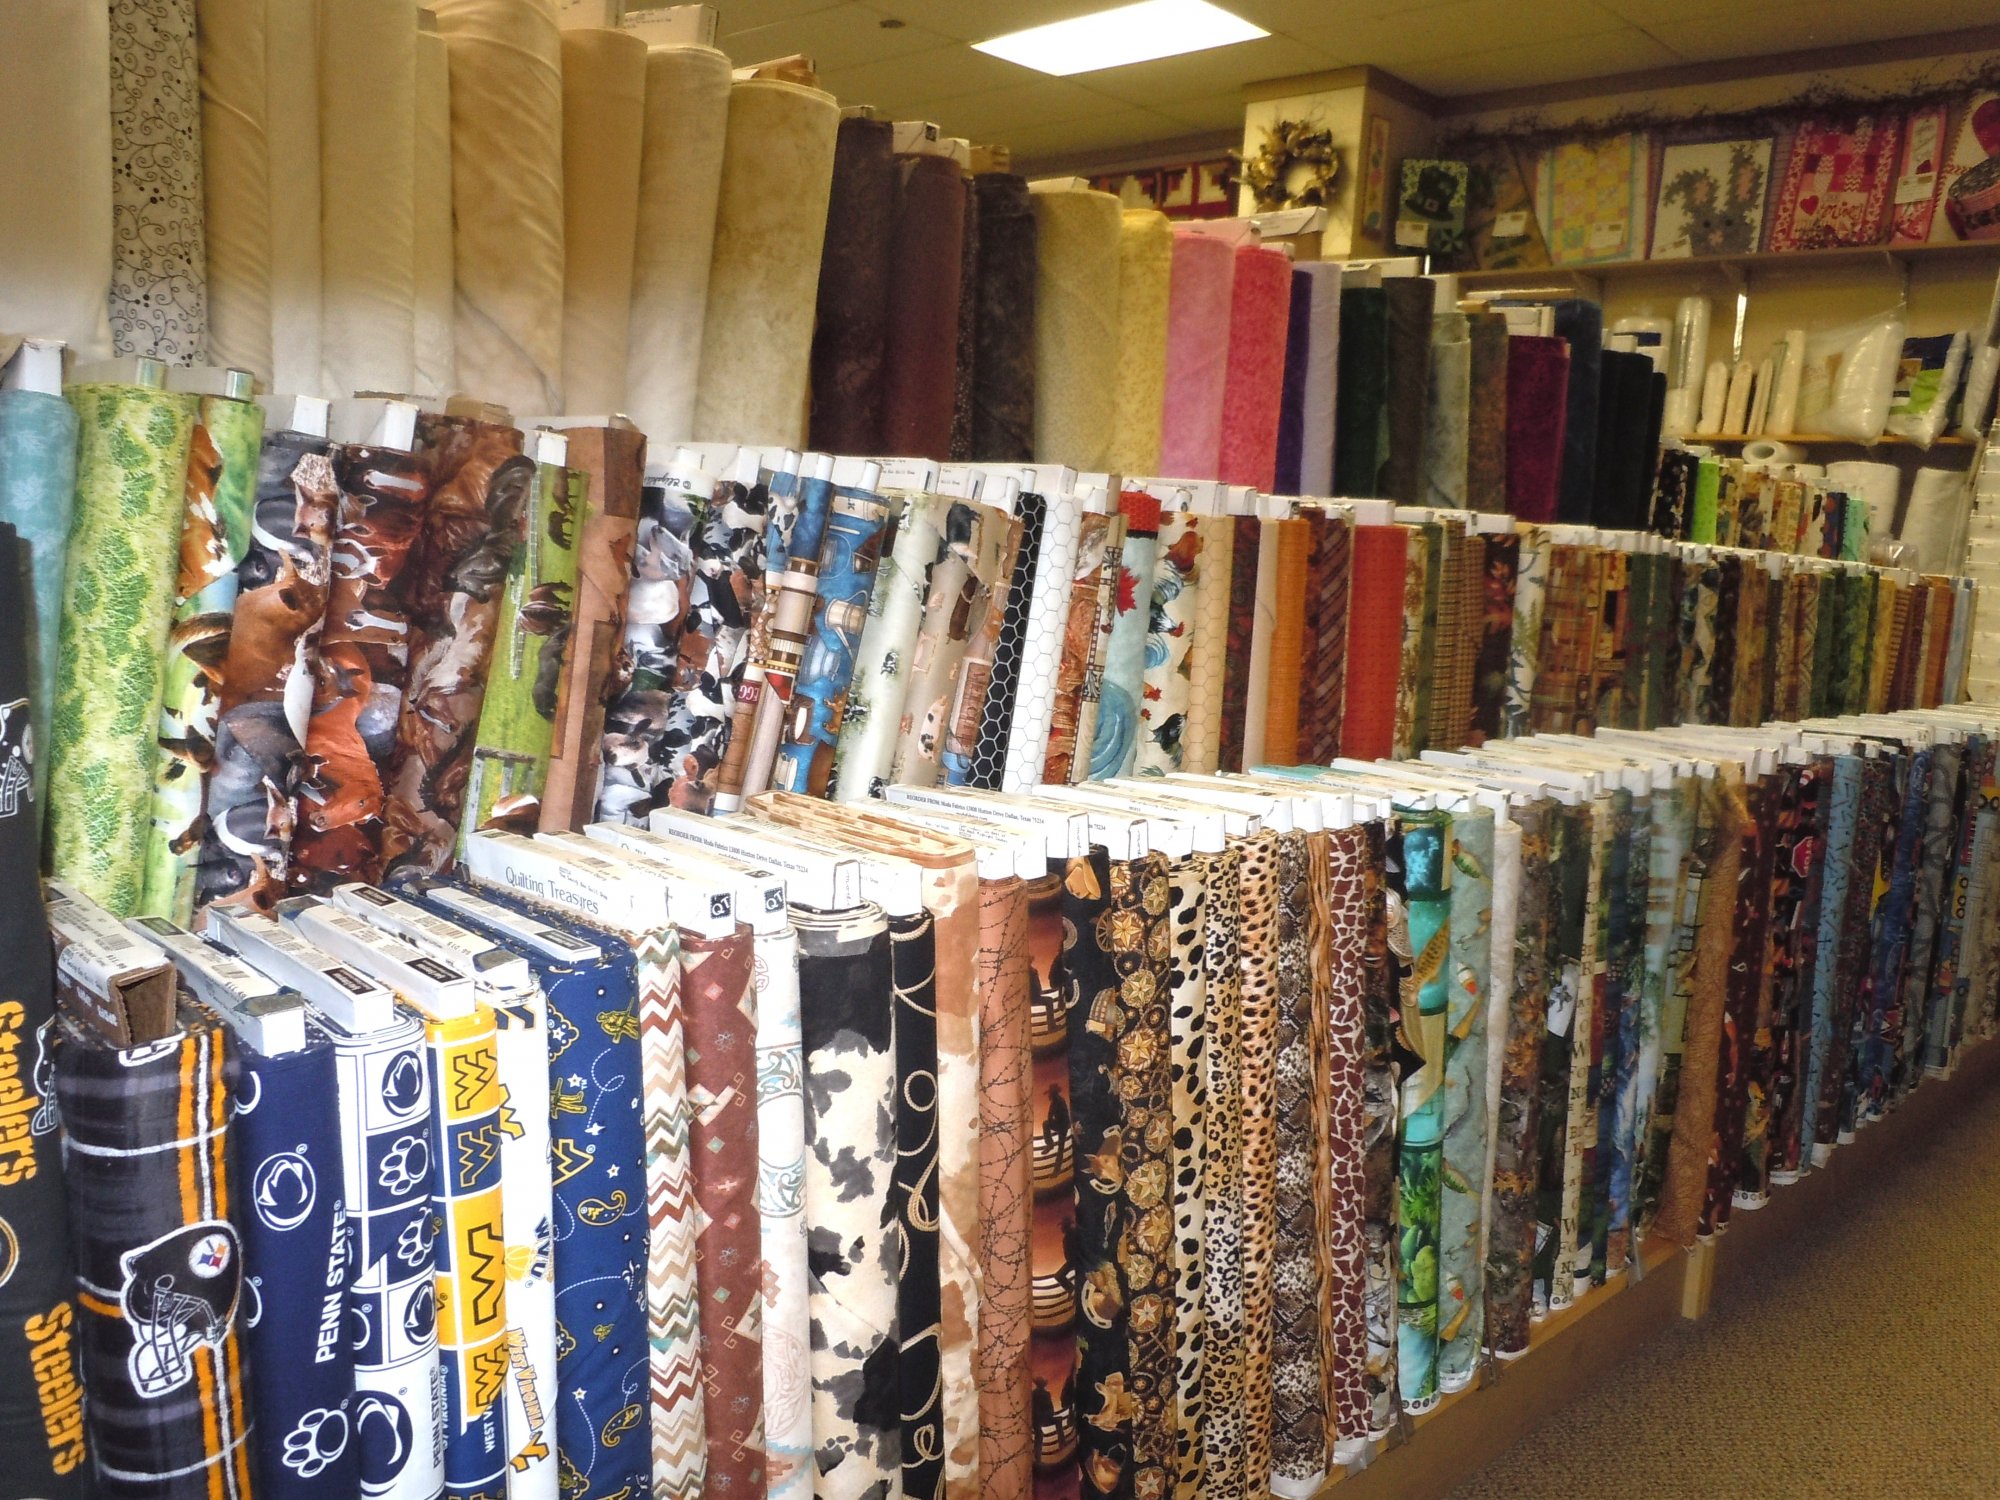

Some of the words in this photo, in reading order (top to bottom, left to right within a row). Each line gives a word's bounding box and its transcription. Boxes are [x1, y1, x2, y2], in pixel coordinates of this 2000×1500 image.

[505, 866, 544, 898] Quilting
[766, 890, 783, 910] QT
[712, 896, 730, 916] QT
[326, 1206, 347, 1287] STATE
[530, 1216, 550, 1279] WVU
[315, 1291, 343, 1364] PENN
[24, 1301, 86, 1475] Steelers
[431, 1425, 442, 1469] PENN
[483, 1421, 496, 1454] WEST
